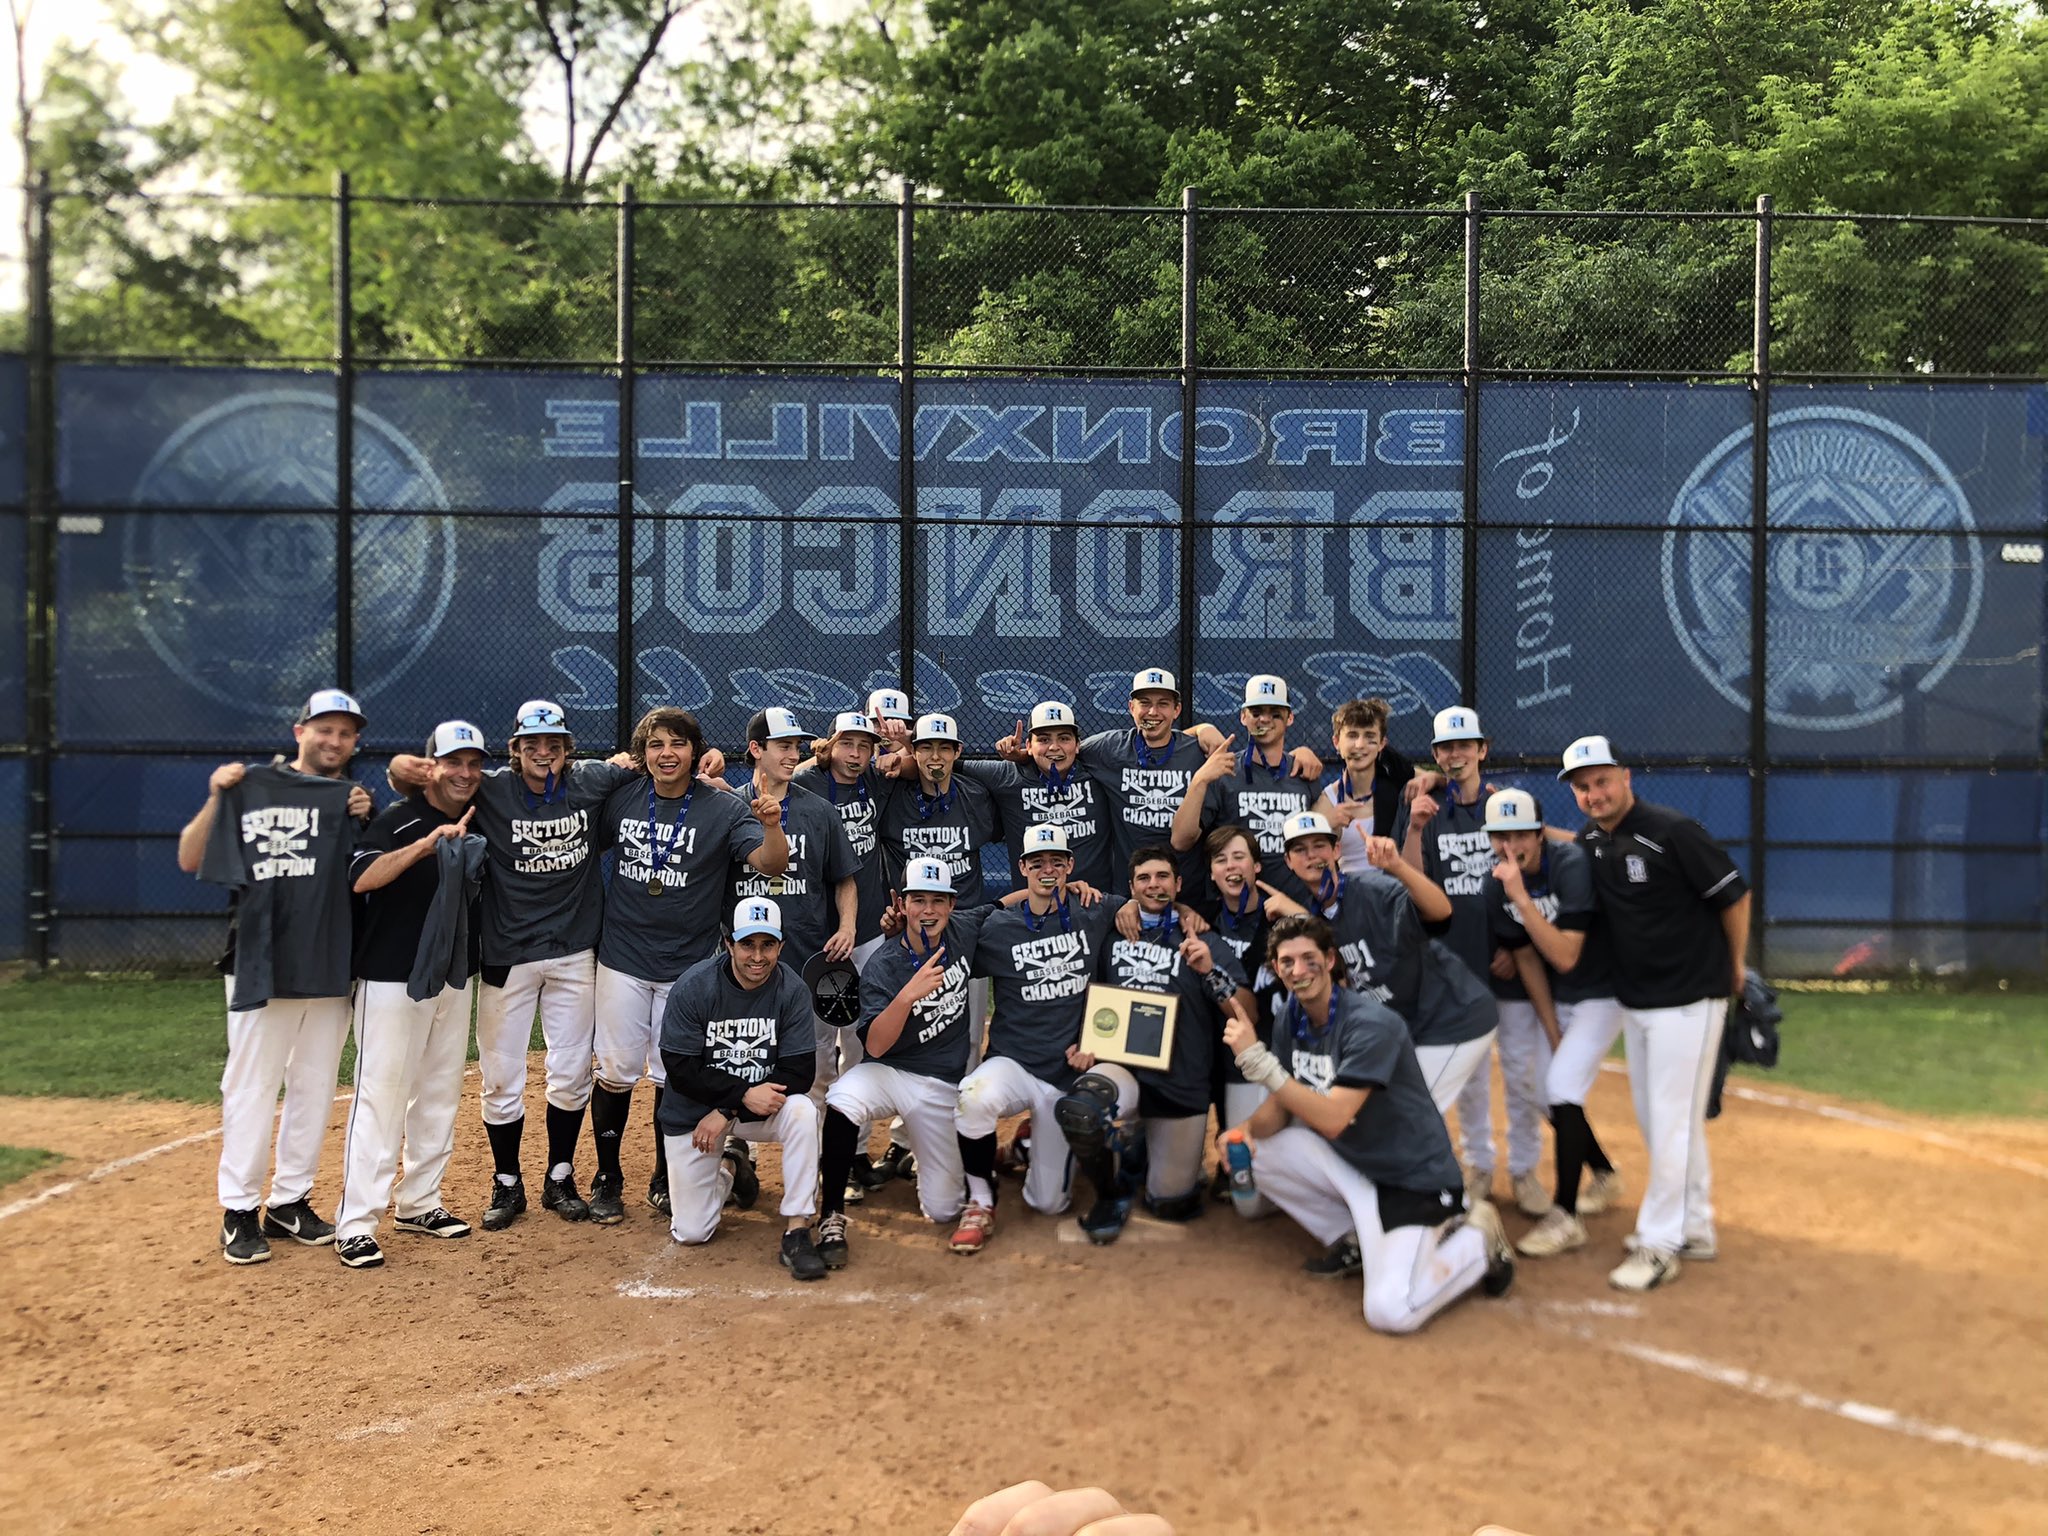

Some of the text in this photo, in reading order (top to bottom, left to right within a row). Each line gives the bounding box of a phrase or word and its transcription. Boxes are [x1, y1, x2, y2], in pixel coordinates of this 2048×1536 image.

[1121, 767, 1183, 792] SECTION
[1021, 780, 1094, 811] SECON 1
[1134, 796, 1177, 806] BASEBALL
[1238, 791, 1300, 818] SECTION
[310, 807, 320, 837] 1
[511, 811, 580, 844] SECTION
[1037, 809, 1080, 821] BASEBALL
[1122, 807, 1174, 828] CHAMPI
[529, 841, 576, 855] BASEBALL
[618, 817, 697, 854] SECION 1
[799, 834, 806, 860] 1
[902, 826, 971, 851] SECTION 1
[514, 841, 589, 873] CHAMPION
[628, 848, 675, 862] BASEL
[735, 878, 807, 897] CHAMION
[1443, 876, 1483, 896] CHAM
[1011, 929, 1091, 972] SECTION 1
[1170, 950, 1181, 977] 1
[1032, 962, 1079, 978] BASEBALL
[1021, 972, 1091, 1002] CHAMPIO
[705, 1017, 771, 1047] SECTION
